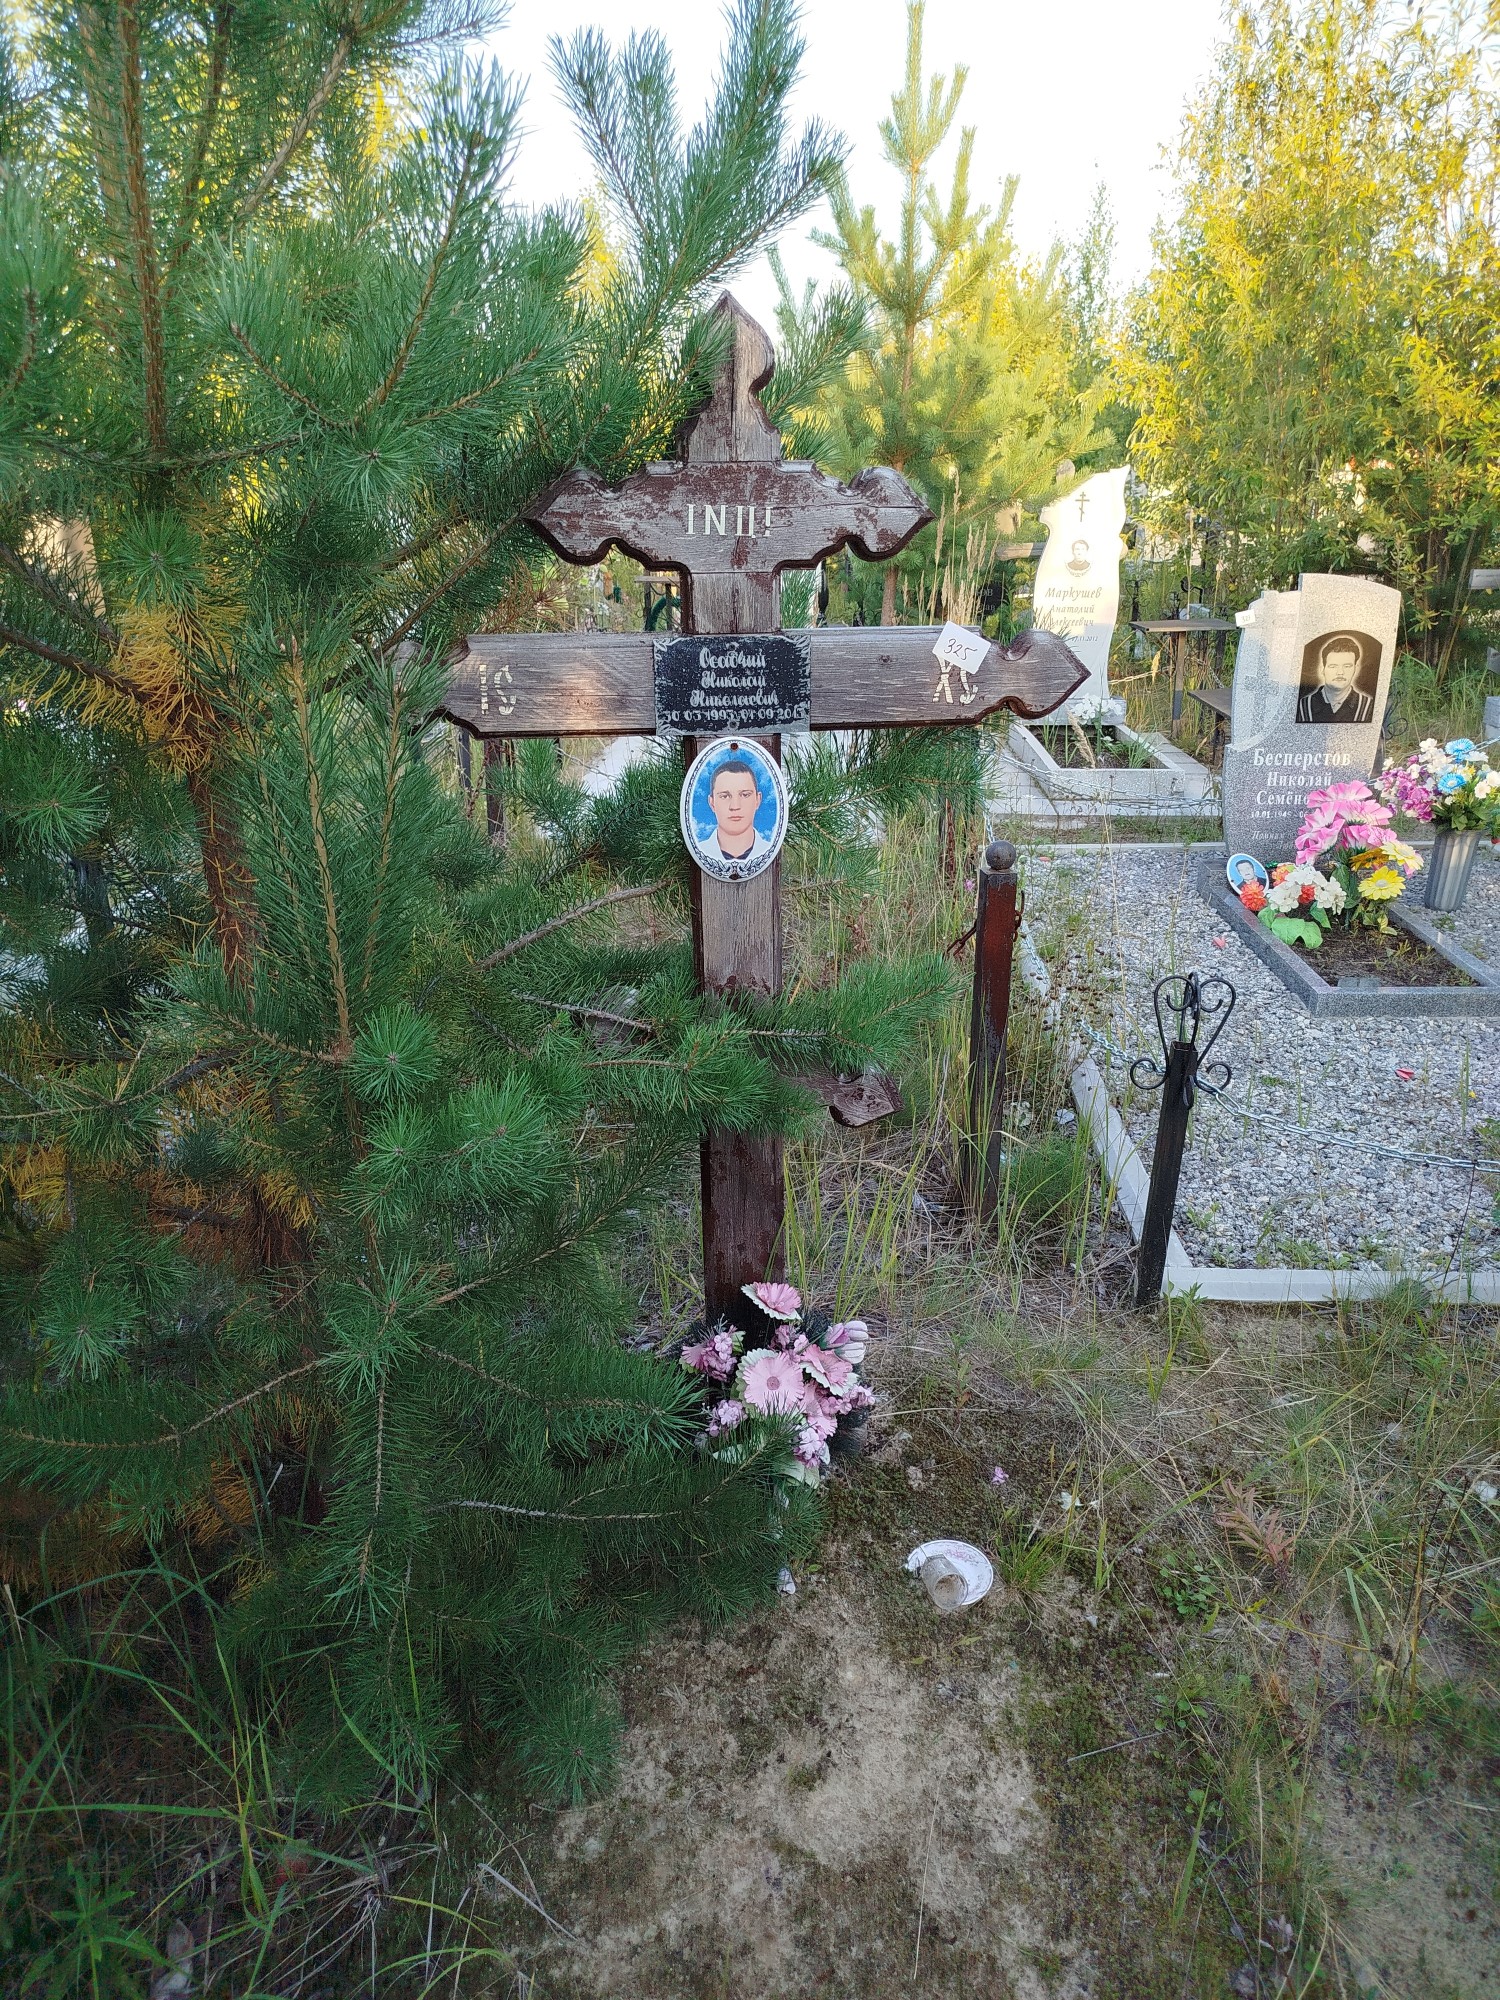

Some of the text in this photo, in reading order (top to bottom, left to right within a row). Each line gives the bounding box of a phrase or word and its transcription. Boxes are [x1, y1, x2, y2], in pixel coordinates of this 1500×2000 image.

[1045, 587, 1102, 601] Маркушев
[943, 638, 978, 661] 325
[700, 670, 767, 689] Николай
[1253, 748, 1351, 770] Бесперстов
[1267, 771, 1332, 787] Николай
